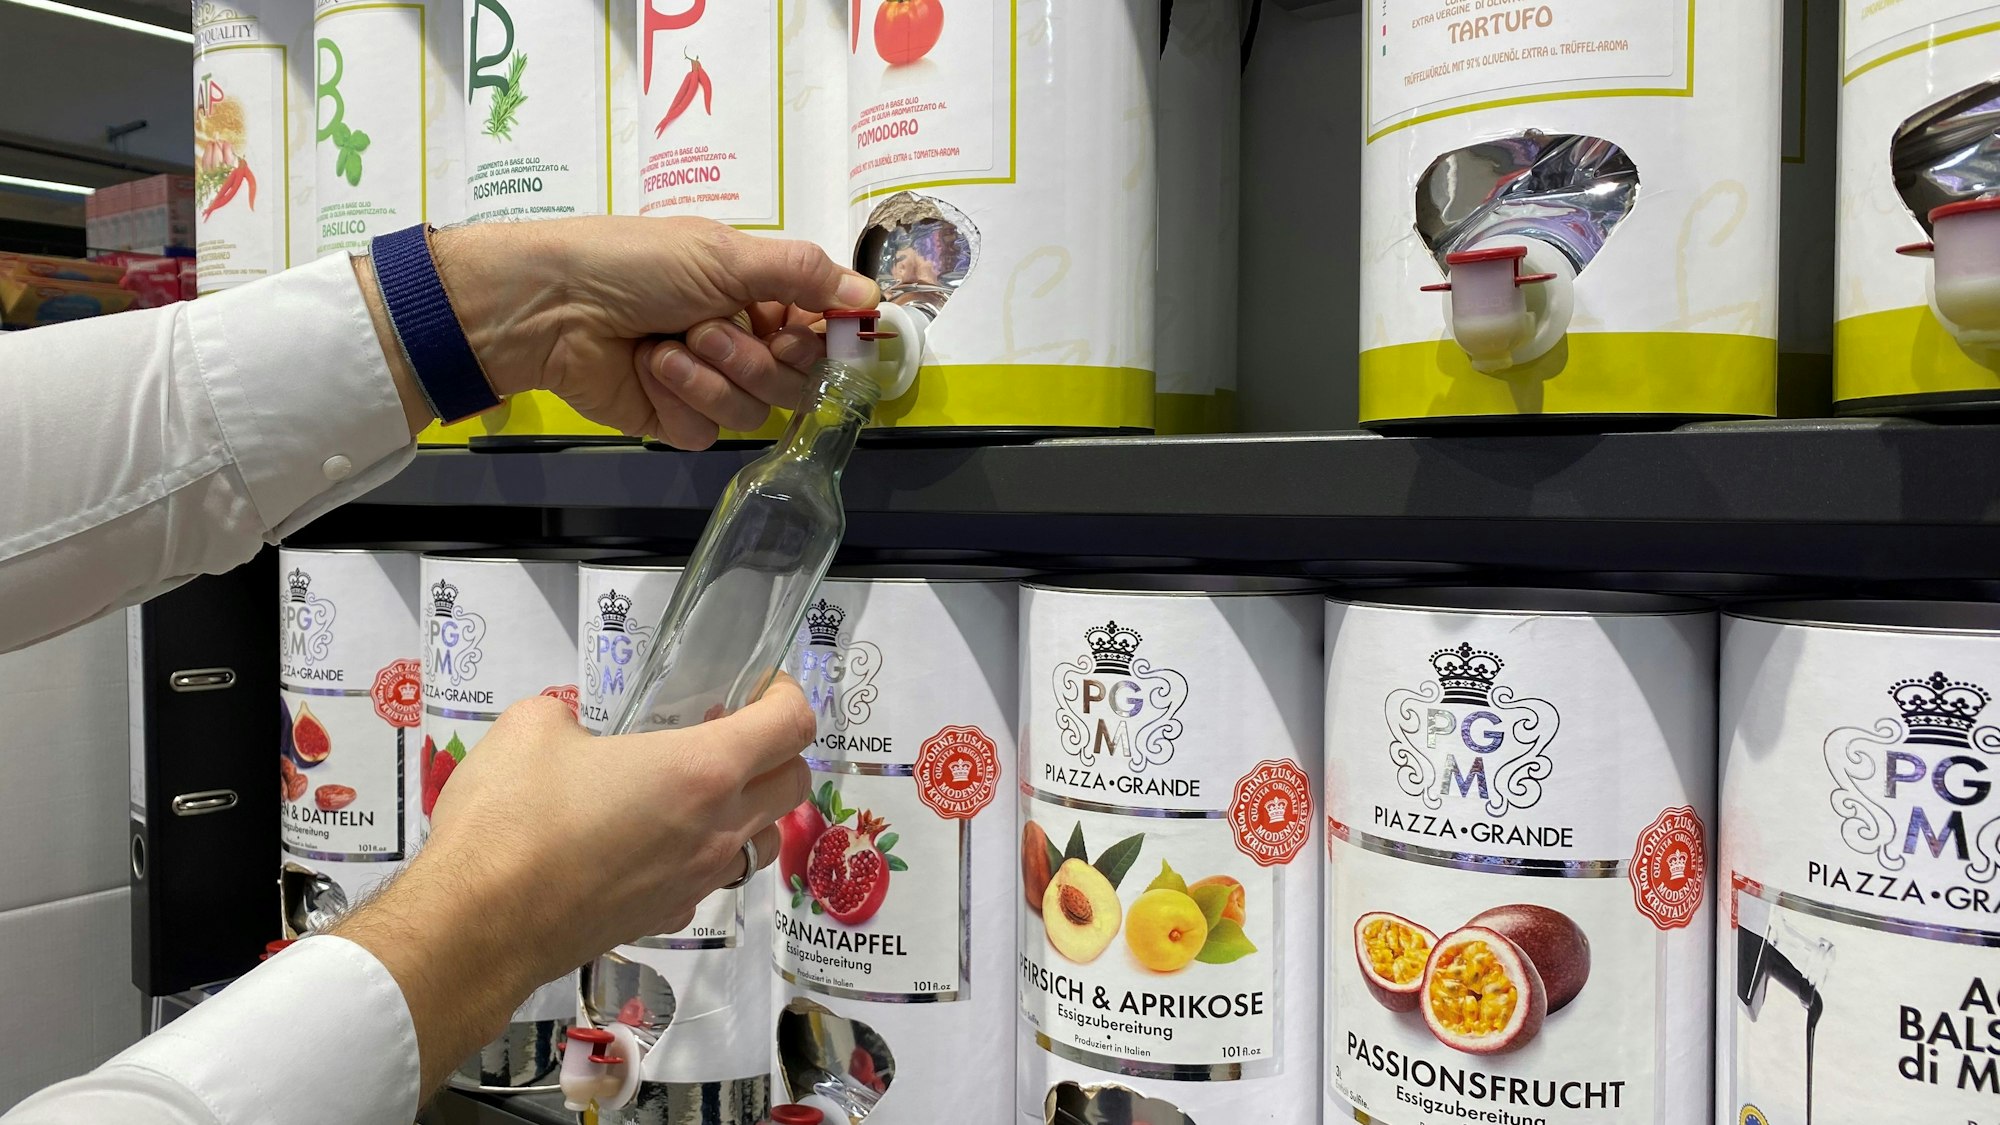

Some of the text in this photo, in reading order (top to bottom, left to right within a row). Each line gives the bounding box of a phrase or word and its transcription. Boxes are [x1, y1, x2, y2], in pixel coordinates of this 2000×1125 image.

[1412, 13, 1434, 28] EXTRA
[1435, 3, 1471, 20] VERGINE
[1447, 5, 1553, 44] TARTUFO
[205, 24, 252, 44] QUALITY
[1451, 59, 1465, 73] MIT
[1466, 57, 1481, 70] 97%
[1482, 48, 1520, 66] OLIVENÖL
[1521, 46, 1549, 60] EXTRA
[1559, 39, 1629, 55] TRÜFFEL-AROMA
[890, 99, 904, 108] BASE
[904, 96, 919, 105] OLIO
[891, 103, 937, 116] AROMATIZZATO
[937, 101, 947, 109] AL
[857, 118, 919, 149] POMODORO
[509, 158, 525, 166] BASE
[525, 157, 541, 165] OLIO
[679, 147, 693, 156] BASE
[694, 145, 709, 153] OLIO
[680, 152, 727, 164] AROMATIZZATO
[728, 152, 738, 160] AL
[913, 147, 960, 160] TOMATEN-AROMA
[510, 164, 559, 174] AROMATIZZATO
[560, 164, 570, 172] AL
[643, 165, 721, 194] PEPERONCINO
[473, 176, 543, 200] ROSMARINO
[696, 192, 740, 202] PEPERONI-AROMA
[529, 205, 575, 214] ROSMARIN-AROMA
[322, 220, 366, 238] BASILICO
[286, 606, 312, 631] PG
[430, 620, 460, 648] PG
[434, 648, 452, 675] M
[596, 635, 633, 665] PG
[602, 664, 625, 695] M
[803, 650, 847, 684] PG
[1082, 678, 1145, 718] PG
[1093, 718, 1132, 758] M
[1426, 707, 1505, 754] PG
[926, 733, 992, 762] OHNE ZUSATZ
[922, 764, 994, 811] VON KRISTALLZUCKER
[939, 781, 980, 798] MODENA
[1240, 767, 1305, 802] OHNE ZUSATZ
[1440, 754, 1489, 800] M
[1884, 749, 1993, 807] PG
[291, 804, 299, 820] &
[302, 807, 374, 826] DATTELN
[1237, 800, 1308, 856] VON KRISTALLZUCKER
[1255, 820, 1296, 841] MODENA
[1643, 819, 1673, 857] OHNE
[1902, 805, 1971, 861] M
[1639, 865, 1649, 890] VON
[1656, 877, 1694, 902] MODENA
[774, 910, 907, 956] GRANATAPFEL
[786, 941, 872, 975] Essigzubereitung
[797, 968, 825, 983] Produziert
[832, 978, 854, 988] Italien
[1019, 952, 1084, 1005] PFIRSICH
[1092, 986, 1111, 1011] &
[1119, 991, 1264, 1019] APRIKOSE
[1959, 977, 2000, 1014] A
[1058, 1003, 1174, 1041] Essigzubereitung
[1074, 1034, 1151, 1057] Produziert in Italien
[1347, 1030, 1626, 1110] PASSIONSFRUCHT
[1898, 1043, 2000, 1094] di M
[1396, 1085, 1546, 1125] Essigzubereitung
